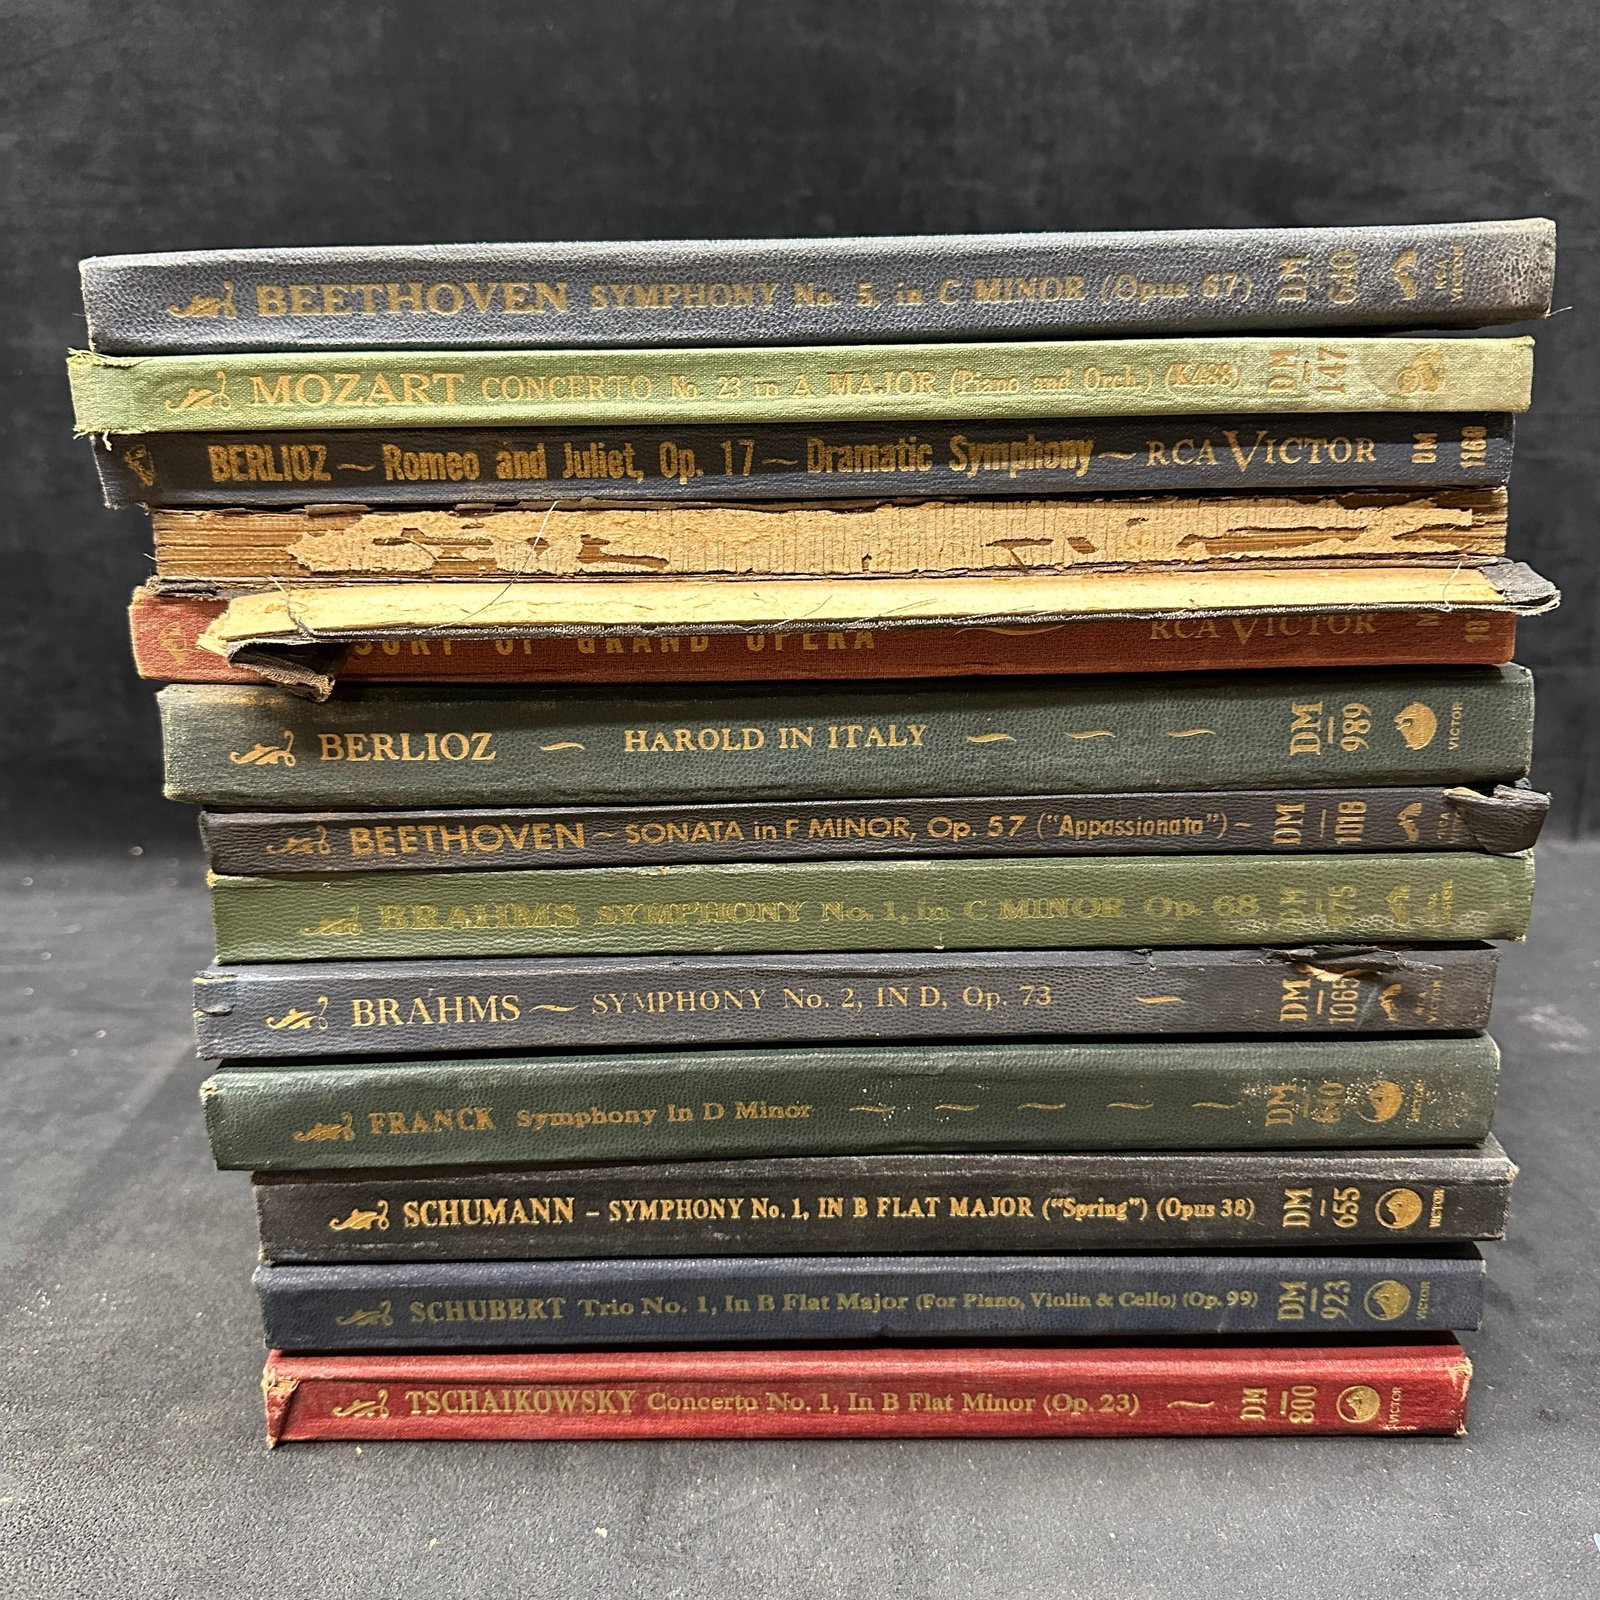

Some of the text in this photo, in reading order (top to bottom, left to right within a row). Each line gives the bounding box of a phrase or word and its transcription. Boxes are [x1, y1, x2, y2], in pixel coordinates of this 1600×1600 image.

[257, 272, 1253, 317] BEETHOVEN SYMPHONY No. 5, in C MINOR (Opus 67)
[1276, 255, 1310, 302] DM
[250, 371, 465, 406] MOZART
[481, 375, 651, 402] CONCERTO
[718, 375, 743, 398] 23
[792, 372, 816, 397] A
[827, 370, 938, 396] MAJOR
[950, 367, 1020, 397] (Piano
[1033, 367, 1072, 390] and
[1267, 349, 1300, 392] DM
[208, 430, 1379, 486] BERLIOZ Romeo and Juliet, Op. 17 Dramatic Symphony RCA VICTOR
[1411, 432, 1438, 464] DM
[319, 723, 927, 763] BERLIOZ HAROLD IN ITALY
[1290, 700, 1323, 756] DM
[1340, 702, 1372, 752] 989
[1448, 700, 1464, 751] VICTOR
[349, 821, 585, 857] BEETHOVEN
[623, 819, 744, 846] SONATA
[753, 818, 778, 842] in
[786, 818, 799, 840] F
[808, 816, 918, 843] MINOR,
[927, 815, 977, 845] Op.
[988, 813, 1025, 837] 57
[1272, 801, 1306, 845] DM
[1334, 800, 1368, 845] 1018
[378, 902, 580, 931] BRAHMS
[594, 900, 803, 926] SYMPHONY
[821, 899, 873, 923] No.
[964, 898, 989, 922] C
[998, 896, 1127, 922] MINOR
[1143, 894, 1203, 921] Op.
[1212, 893, 1260, 917] 68
[352, 983, 1053, 1028] BRAHMS SYMPHONY No. 2, IN D, Op. 73
[1279, 978, 1312, 1022] DM
[1328, 976, 1360, 1024] 1065
[369, 1099, 814, 1136] FRANCK Symphony In D Minor
[1265, 1084, 1297, 1127] DM
[403, 1196, 576, 1229] SCHUMANN
[608, 1197, 742, 1223] SYMPHONY
[751, 1197, 788, 1219] No.
[791, 1197, 810, 1222] 1,
[818, 1197, 844, 1219] IN
[854, 1197, 869, 1219] B
[877, 1196, 941, 1219] FLAT
[949, 1195, 1035, 1219] MAJOR
[1156, 1197, 1216, 1222] (Opus
[1220, 1196, 1256, 1222] 38)
[1282, 1187, 1313, 1228] DM
[1332, 1186, 1361, 1228] 655
[1428, 1188, 1445, 1228] VICTOR
[410, 1288, 1258, 1323] SCHUBERT Trio No. 1, In B Flat Major (For Piano, Violin & Cello) (Op. 99)
[1277, 1280, 1308, 1321] DM
[1320, 1279, 1351, 1320] 923
[1416, 1280, 1431, 1321] VICTOR
[405, 1389, 1140, 1416] TSCHAIKOWSKY Concerto No. 1, In B Flat Minor (Op. 23)
[1239, 1387, 1268, 1421] DM
[1289, 1385, 1317, 1423] 800
[1388, 1386, 1403, 1424] VICTOR
